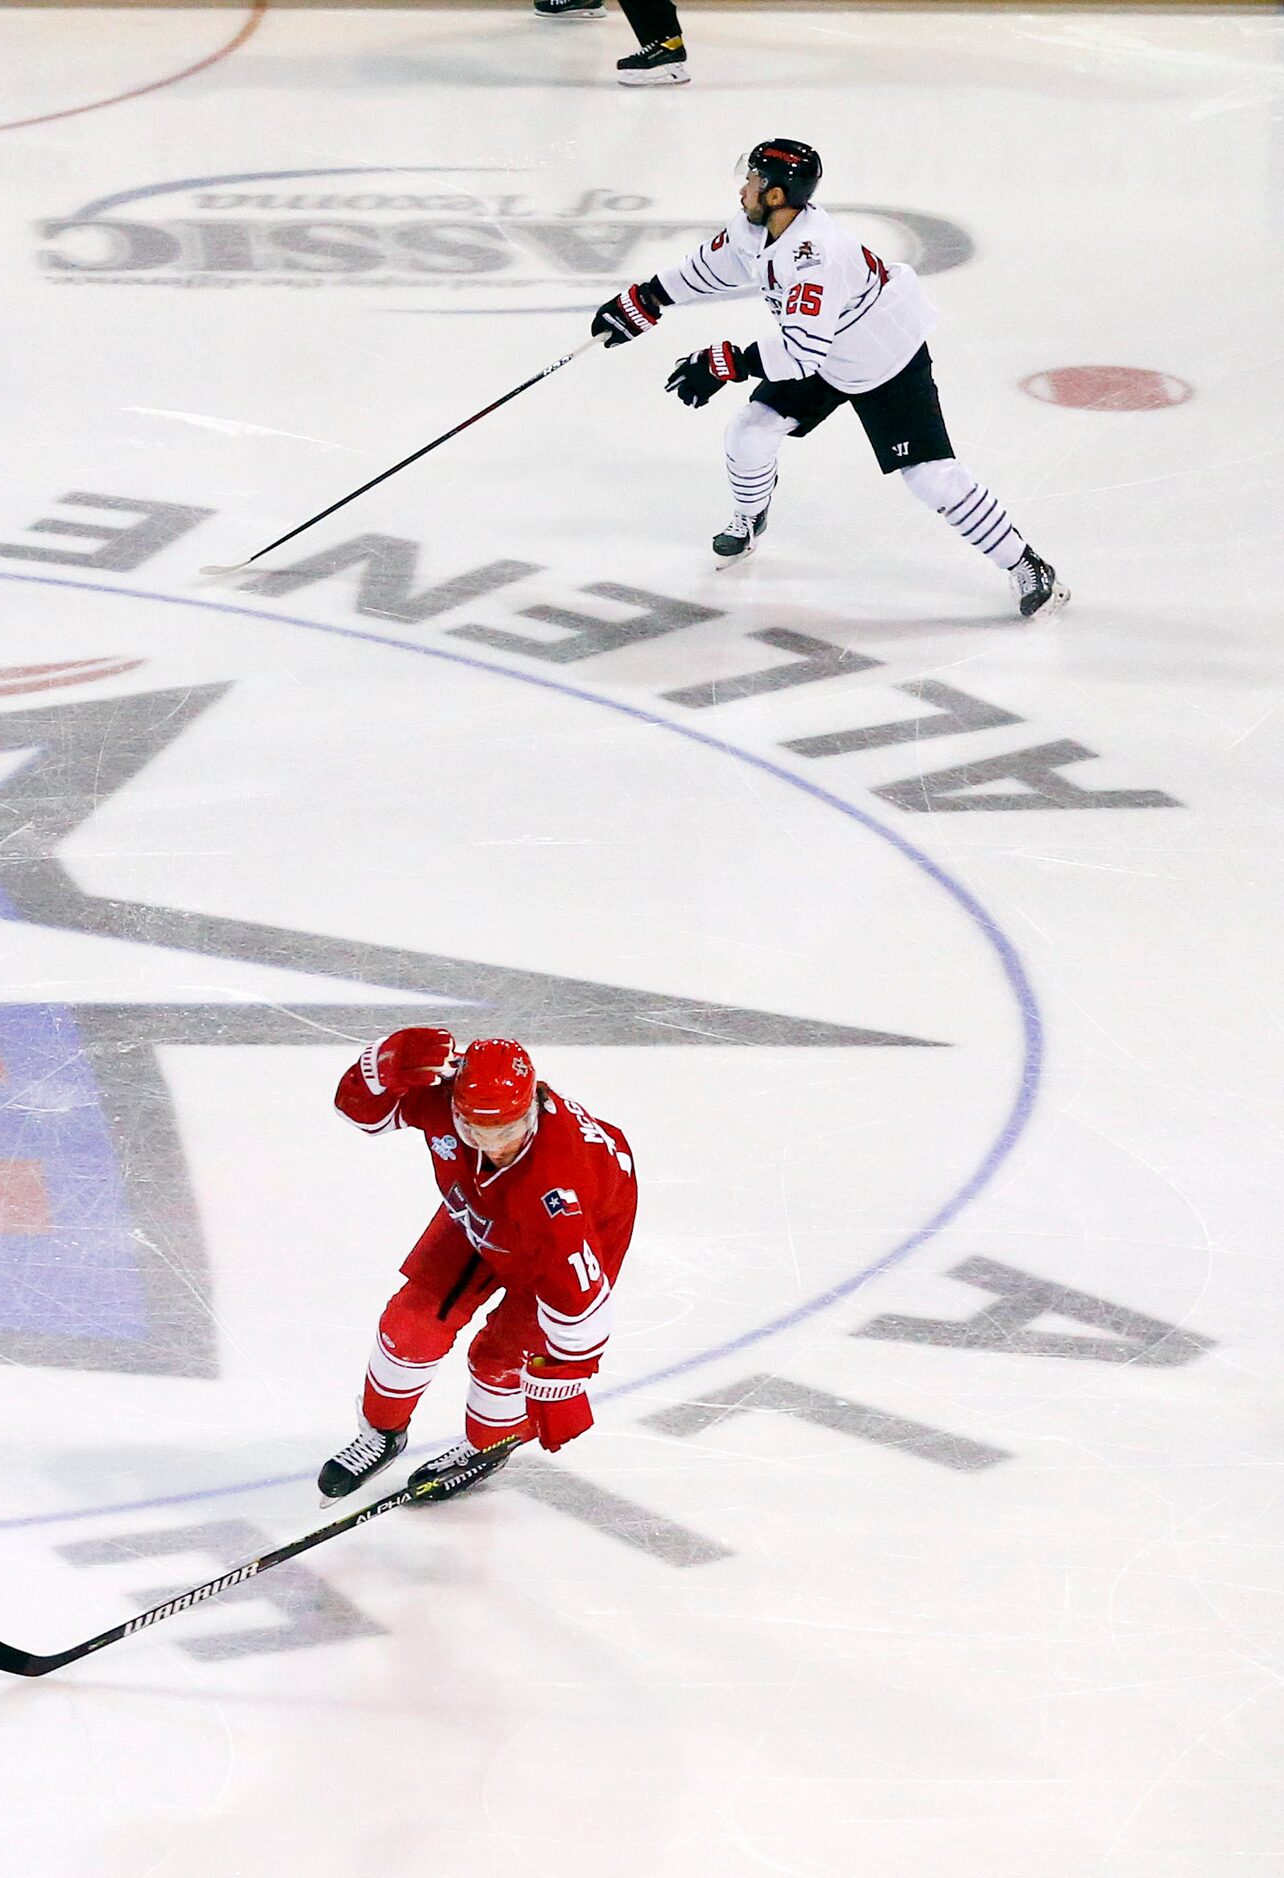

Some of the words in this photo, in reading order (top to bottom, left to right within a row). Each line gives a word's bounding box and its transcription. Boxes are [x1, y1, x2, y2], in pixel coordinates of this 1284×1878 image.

[195, 193, 533, 219] Texoma
[556, 187, 653, 218] of
[786, 283, 824, 317] 25
[236, 534, 1184, 815] ALLEN
[123, 1561, 259, 1638] WARRIOR
[355, 1492, 414, 1525] ALPHA
